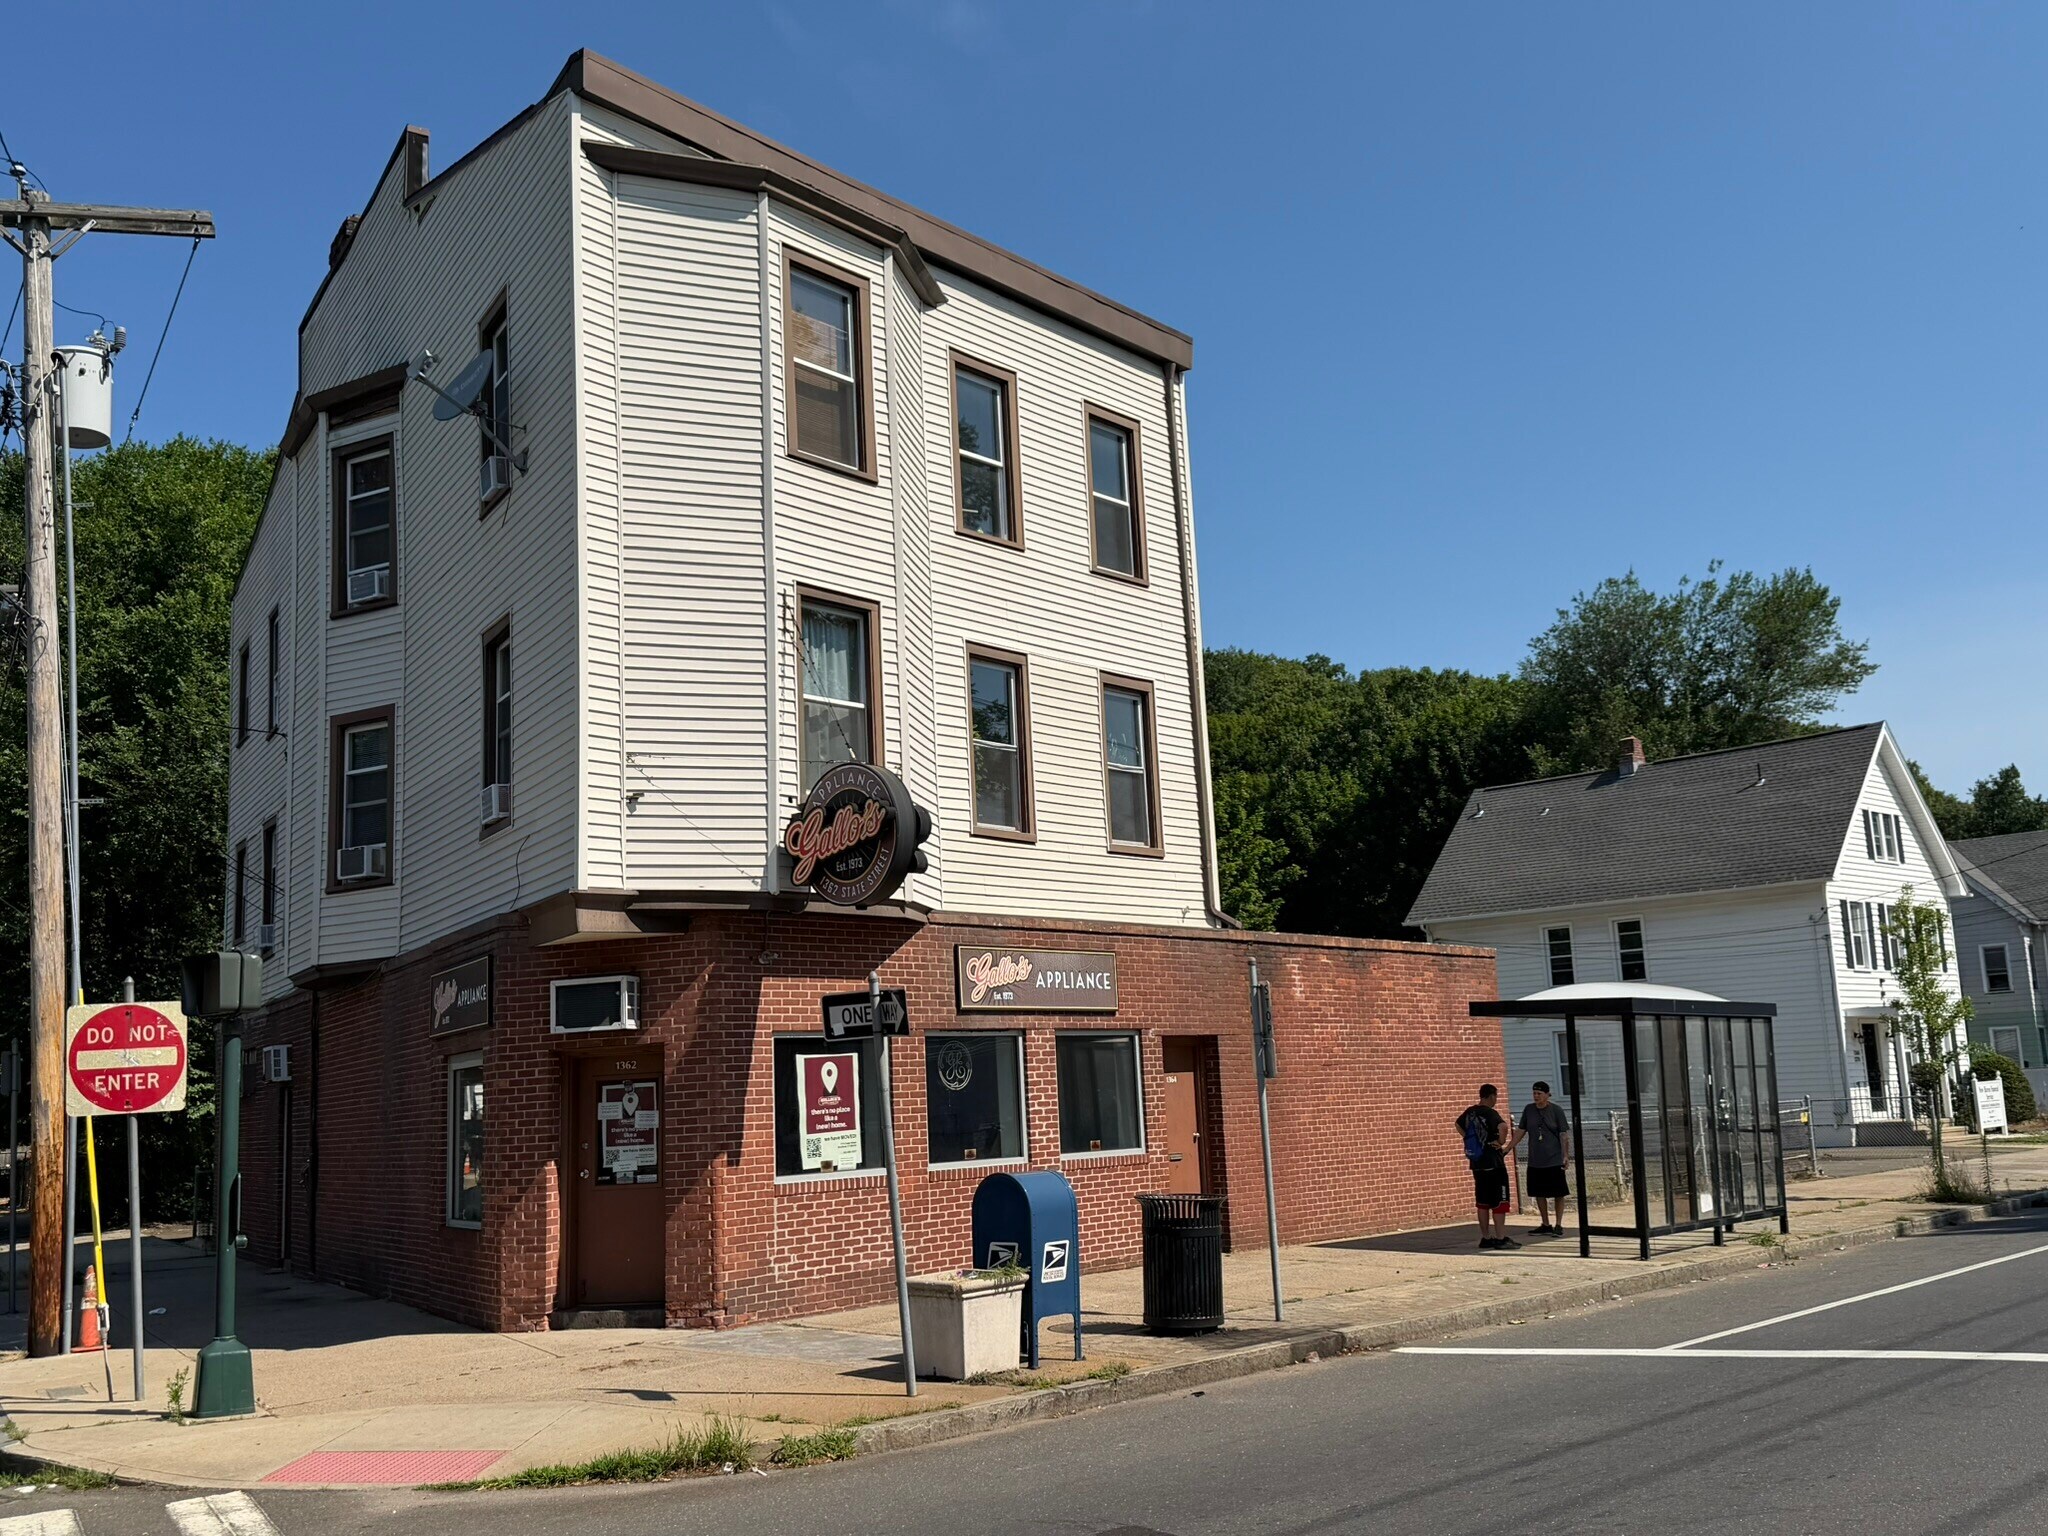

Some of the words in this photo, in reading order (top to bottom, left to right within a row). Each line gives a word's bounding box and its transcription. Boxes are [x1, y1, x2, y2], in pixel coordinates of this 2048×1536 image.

[812, 772, 881, 807] APPLIANCE
[785, 799, 886, 885] Gallo's
[819, 876, 839, 896] 1362
[841, 881, 866, 898] STATE
[867, 847, 890, 886] STREET
[836, 861, 848, 871] Est.
[848, 857, 863, 869] 1973
[967, 952, 1033, 1002] Gallo's
[1035, 971, 1111, 990] APPLIANCE
[457, 983, 487, 1007] APPLIANCE
[841, 1005, 873, 1024] ONE
[881, 1003, 898, 1021] WAY
[1263, 984, 1272, 1035] STOP
[87, 1027, 114, 1044] DO
[129, 1024, 168, 1042] NOT
[615, 1060, 637, 1070] 1362
[95, 1072, 160, 1092] ENTER
[836, 1106, 851, 1115] place
